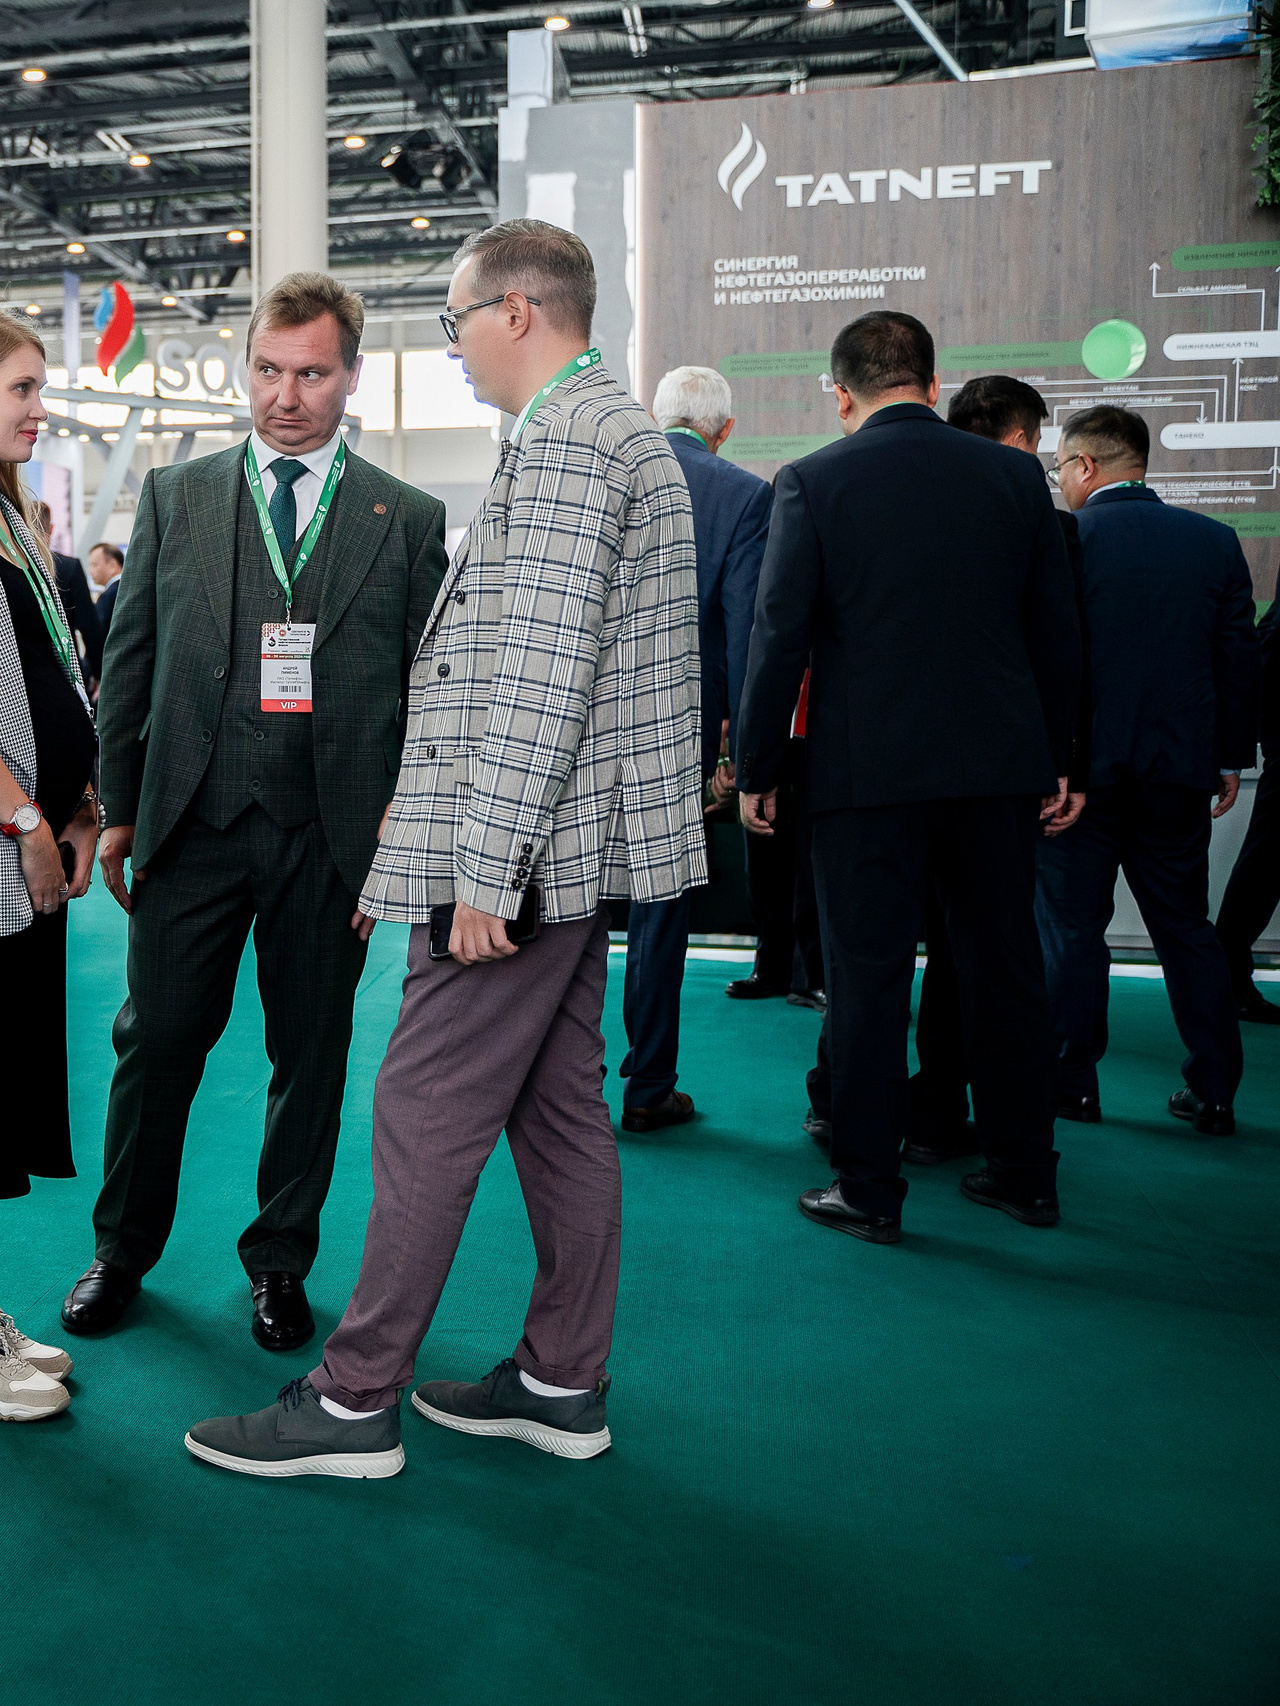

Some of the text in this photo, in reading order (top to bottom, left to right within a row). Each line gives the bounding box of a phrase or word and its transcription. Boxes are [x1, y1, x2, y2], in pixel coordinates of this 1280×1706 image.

[775, 160, 1052, 208] TATNEFT
[714, 255, 798, 273] СИНЕРГИЯ
[714, 266, 926, 289] НЕФТЕГАЗОПЕРЕРАБОТКИ
[714, 284, 885, 305] И НЕФТЕГАЗОХИМИИ
[280, 701, 297, 709] VIP
